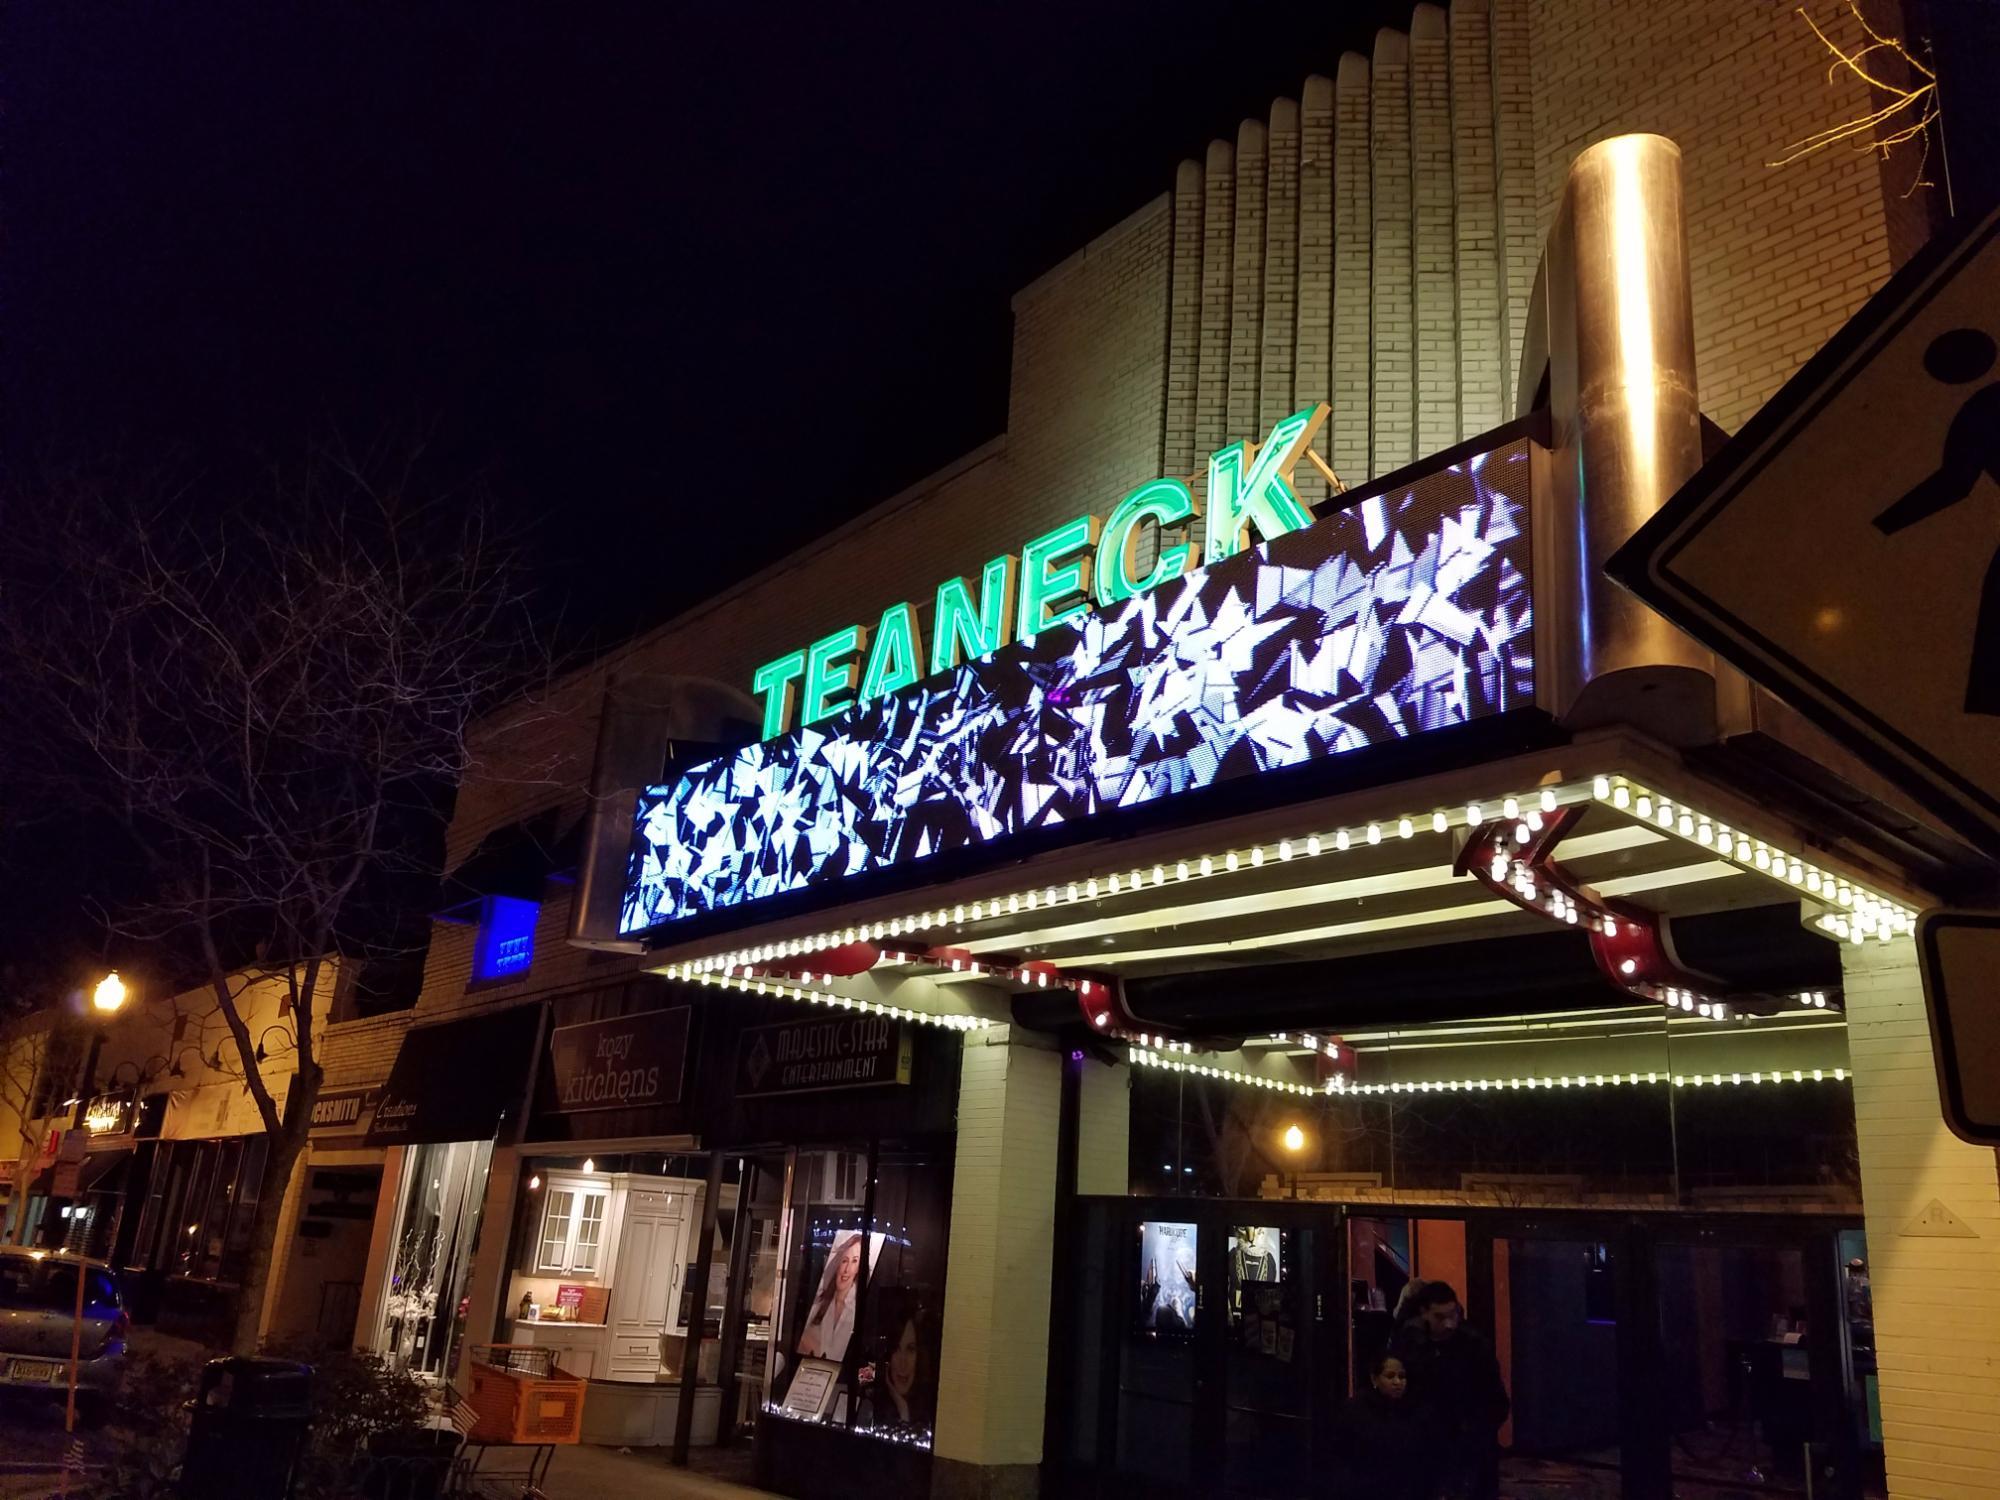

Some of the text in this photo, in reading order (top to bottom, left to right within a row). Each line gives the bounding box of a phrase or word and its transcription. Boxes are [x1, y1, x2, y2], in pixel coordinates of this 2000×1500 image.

[753, 402, 1330, 742] TEANECK
[596, 1033, 635, 1060] kozy
[776, 1015, 889, 1063] MAJESTIC-STAR
[562, 1059, 659, 1104] kitchens
[782, 1056, 877, 1086] ENTERTAINMENT
